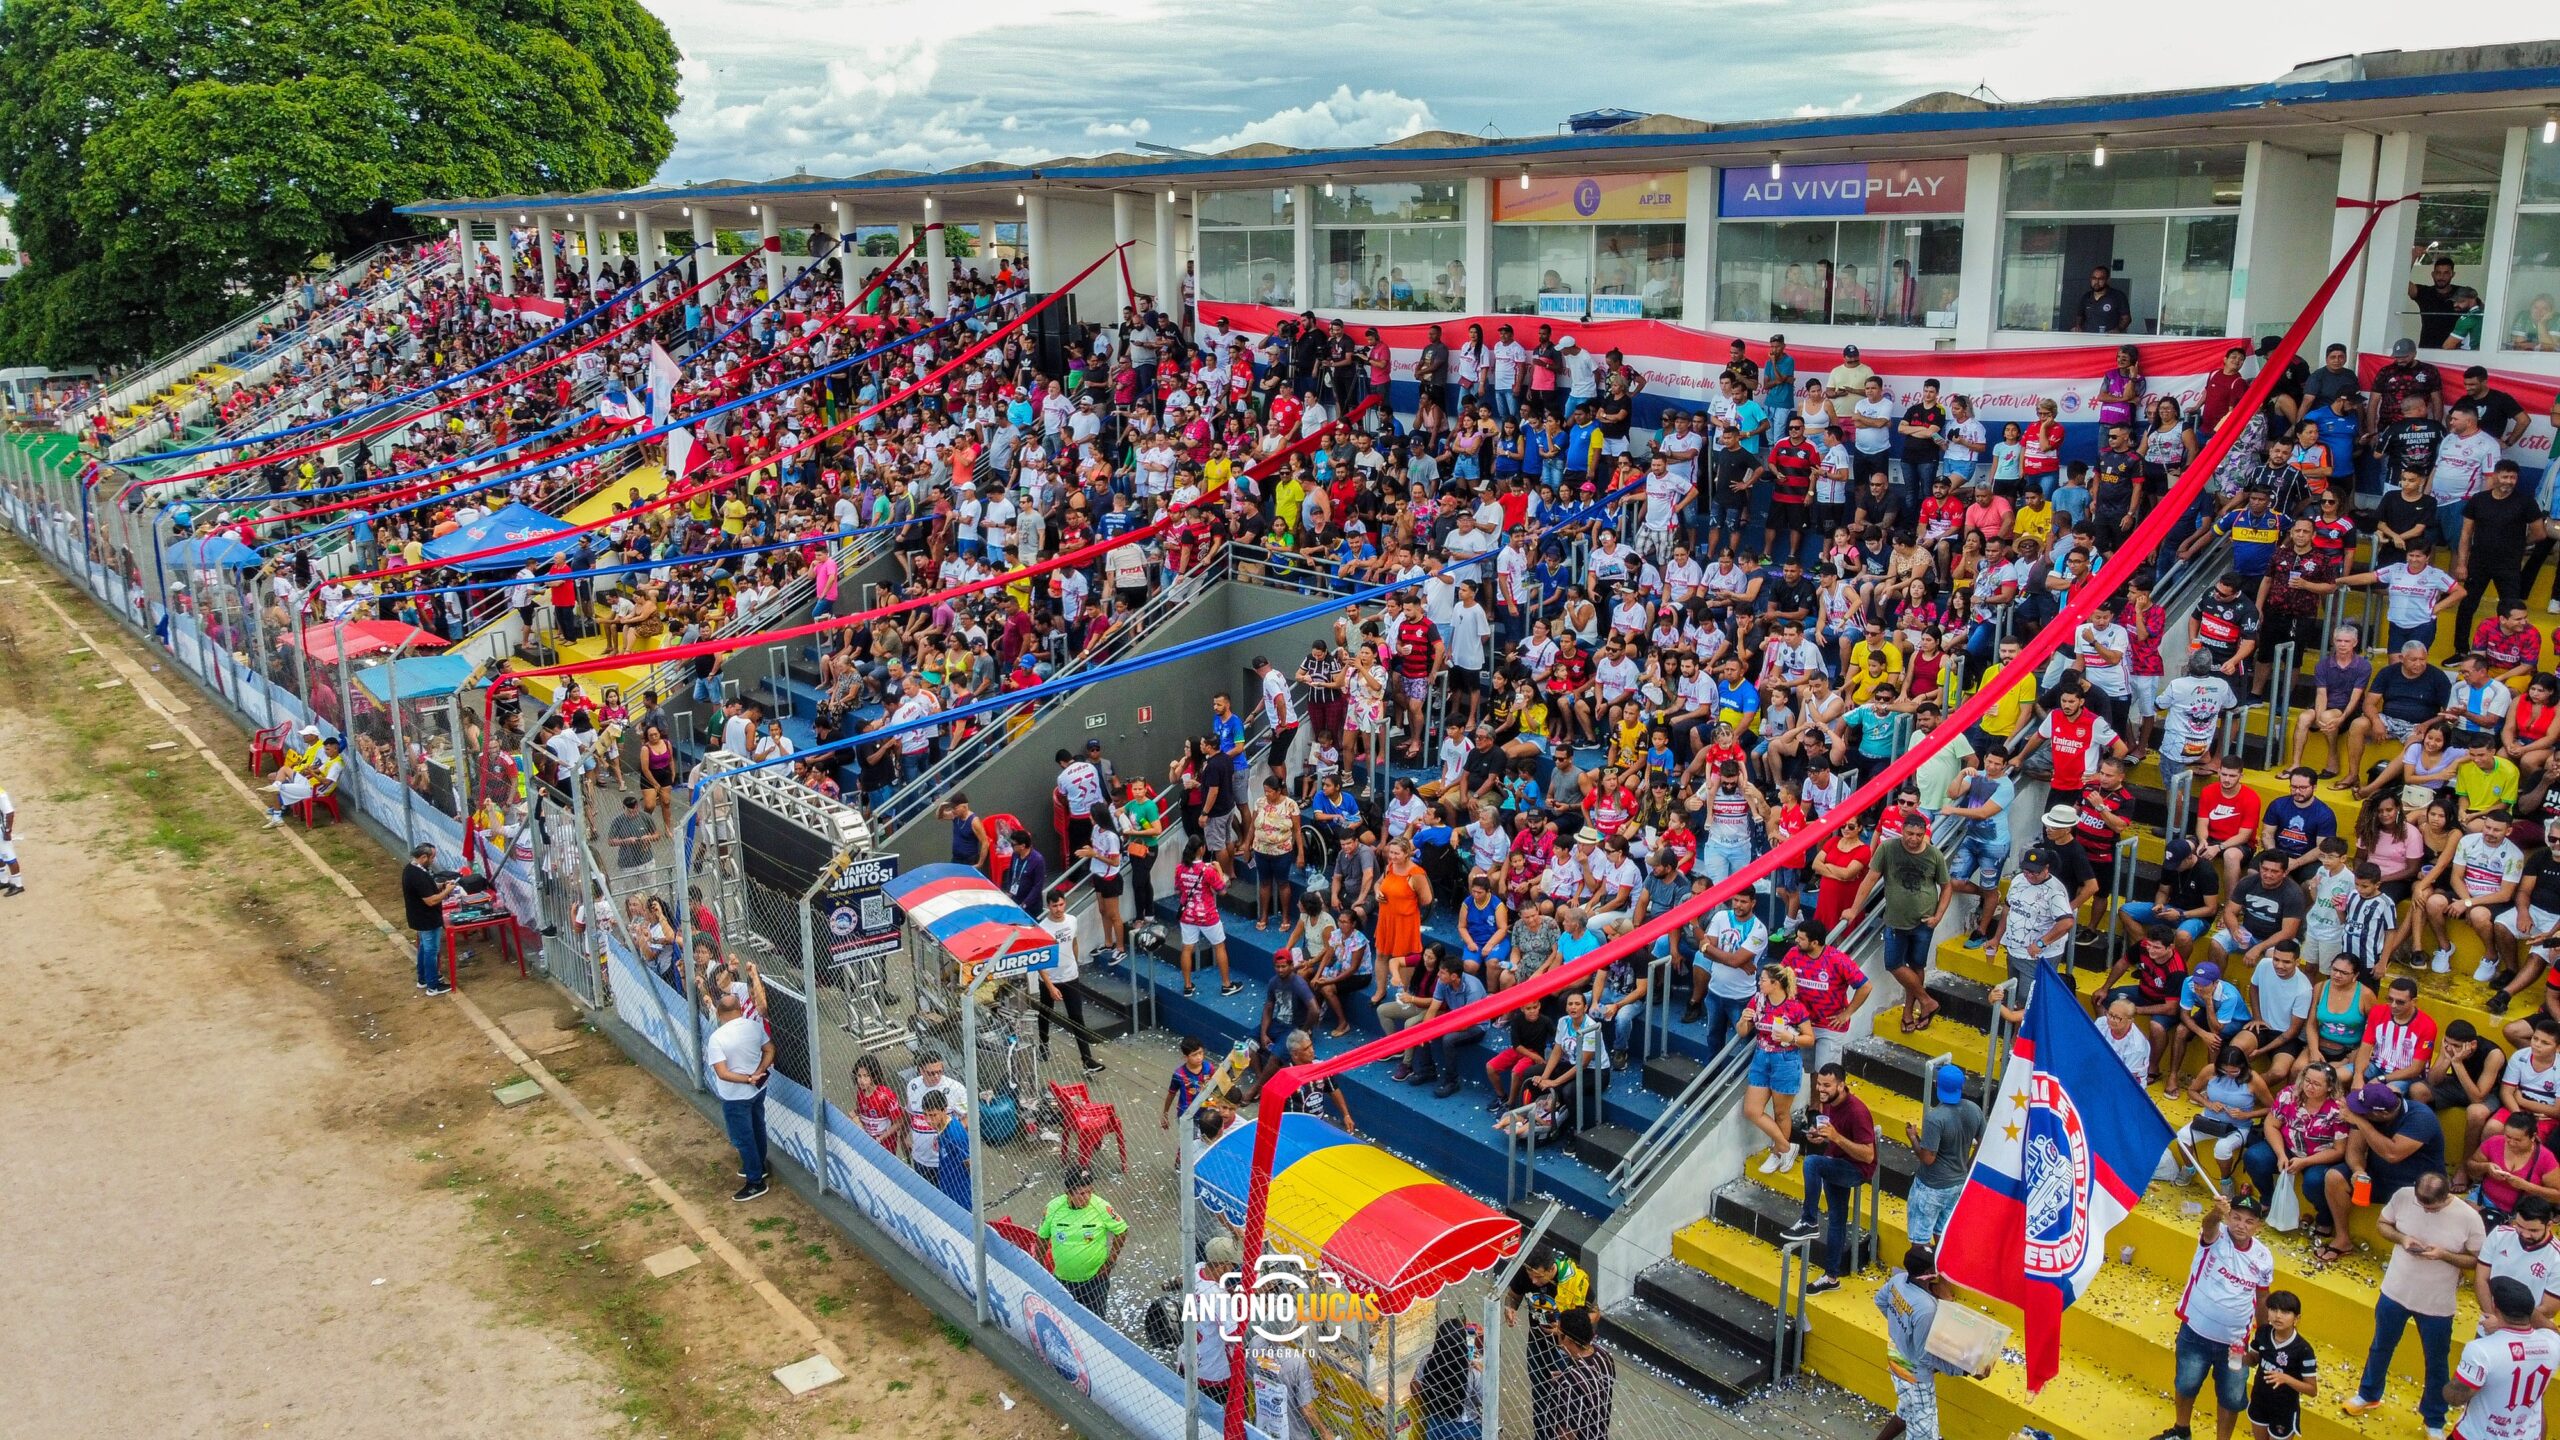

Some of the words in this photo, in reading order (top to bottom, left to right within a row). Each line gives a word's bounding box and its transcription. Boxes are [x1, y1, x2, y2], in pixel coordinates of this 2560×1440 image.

[1743, 182, 1782, 201] AO
[2398, 431, 2436, 441] PRESIDENTE
[2052, 736, 2084, 749] Emirates
[843, 861, 881, 877] VAMOS
[830, 867, 894, 893] JUNTOS!
[2504, 1363, 2553, 1412] 10
